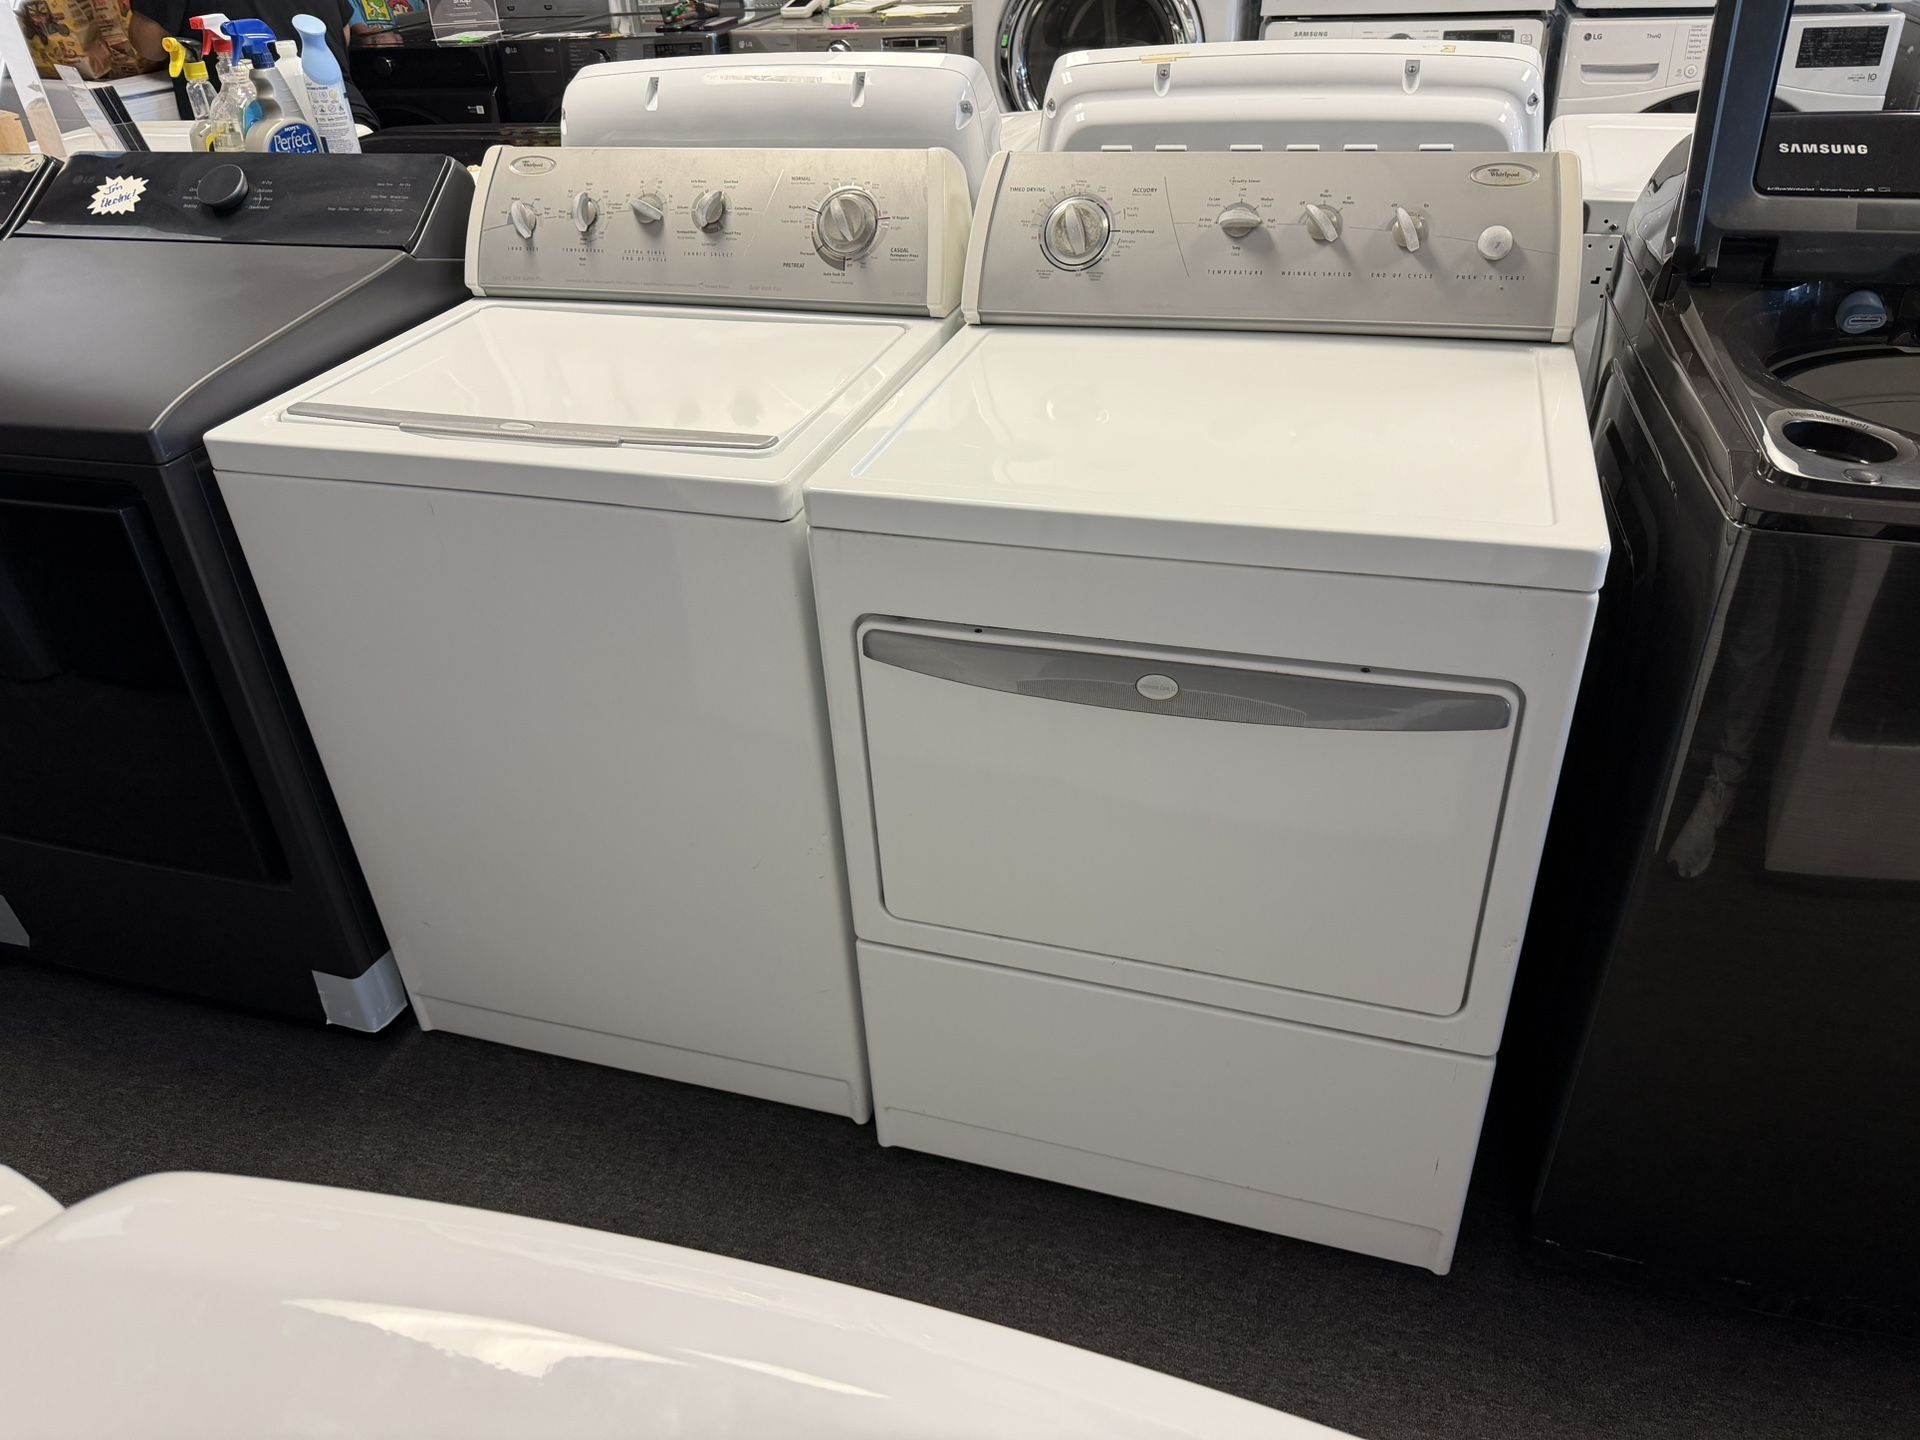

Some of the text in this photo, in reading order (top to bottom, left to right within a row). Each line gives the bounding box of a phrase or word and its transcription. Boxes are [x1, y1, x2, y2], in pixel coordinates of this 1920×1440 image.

[274, 131, 312, 152] Perfect
[1778, 143, 1869, 155] SAMSUNG
[1850, 420, 1872, 430] only
